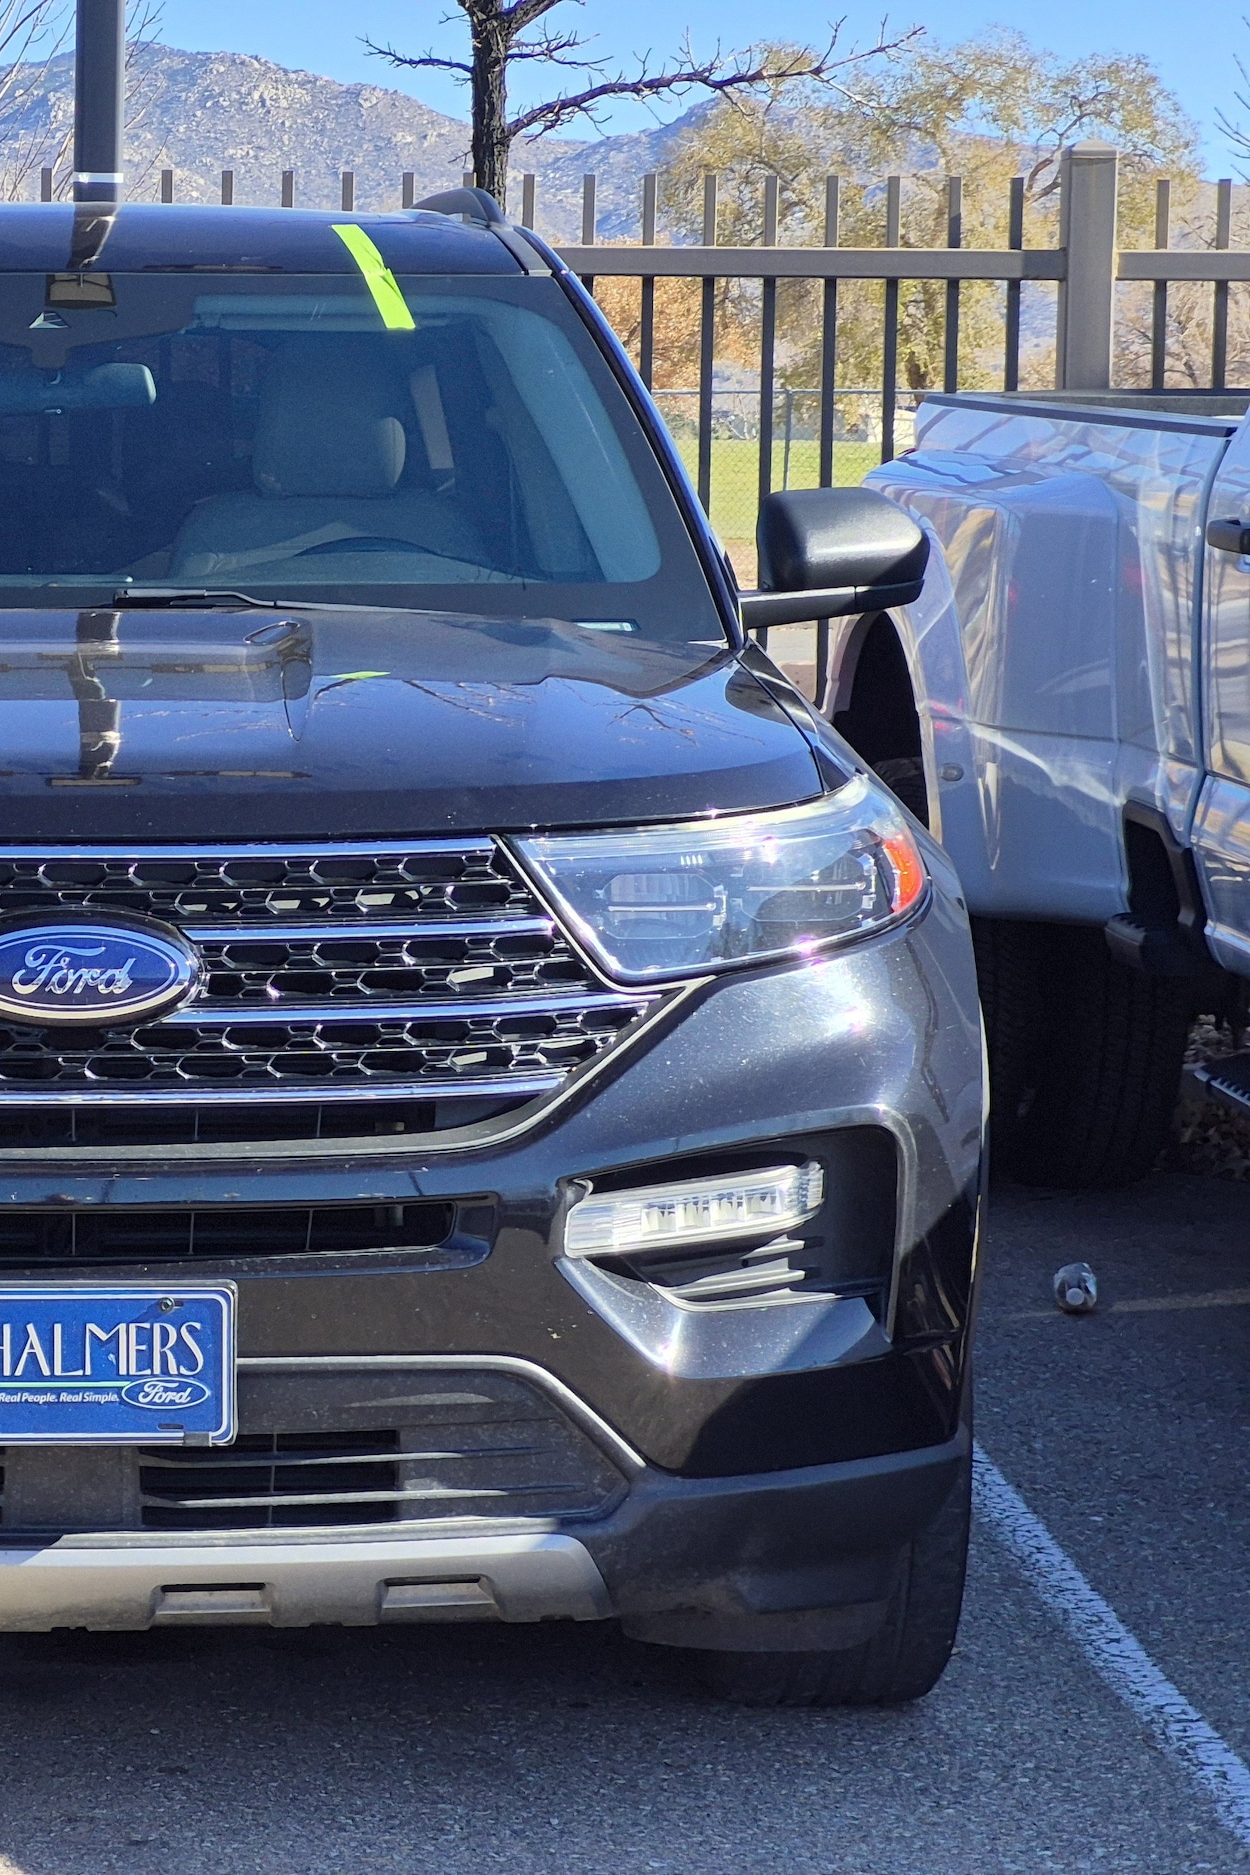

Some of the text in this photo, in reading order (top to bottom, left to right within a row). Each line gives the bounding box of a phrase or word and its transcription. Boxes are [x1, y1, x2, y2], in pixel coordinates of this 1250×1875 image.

[11, 944, 138, 996] Ford
[22, 1391, 58, 1405] People.
[59, 1391, 84, 1403] Real
[83, 1391, 120, 1405] Simple.
[137, 1381, 192, 1405] Ford
